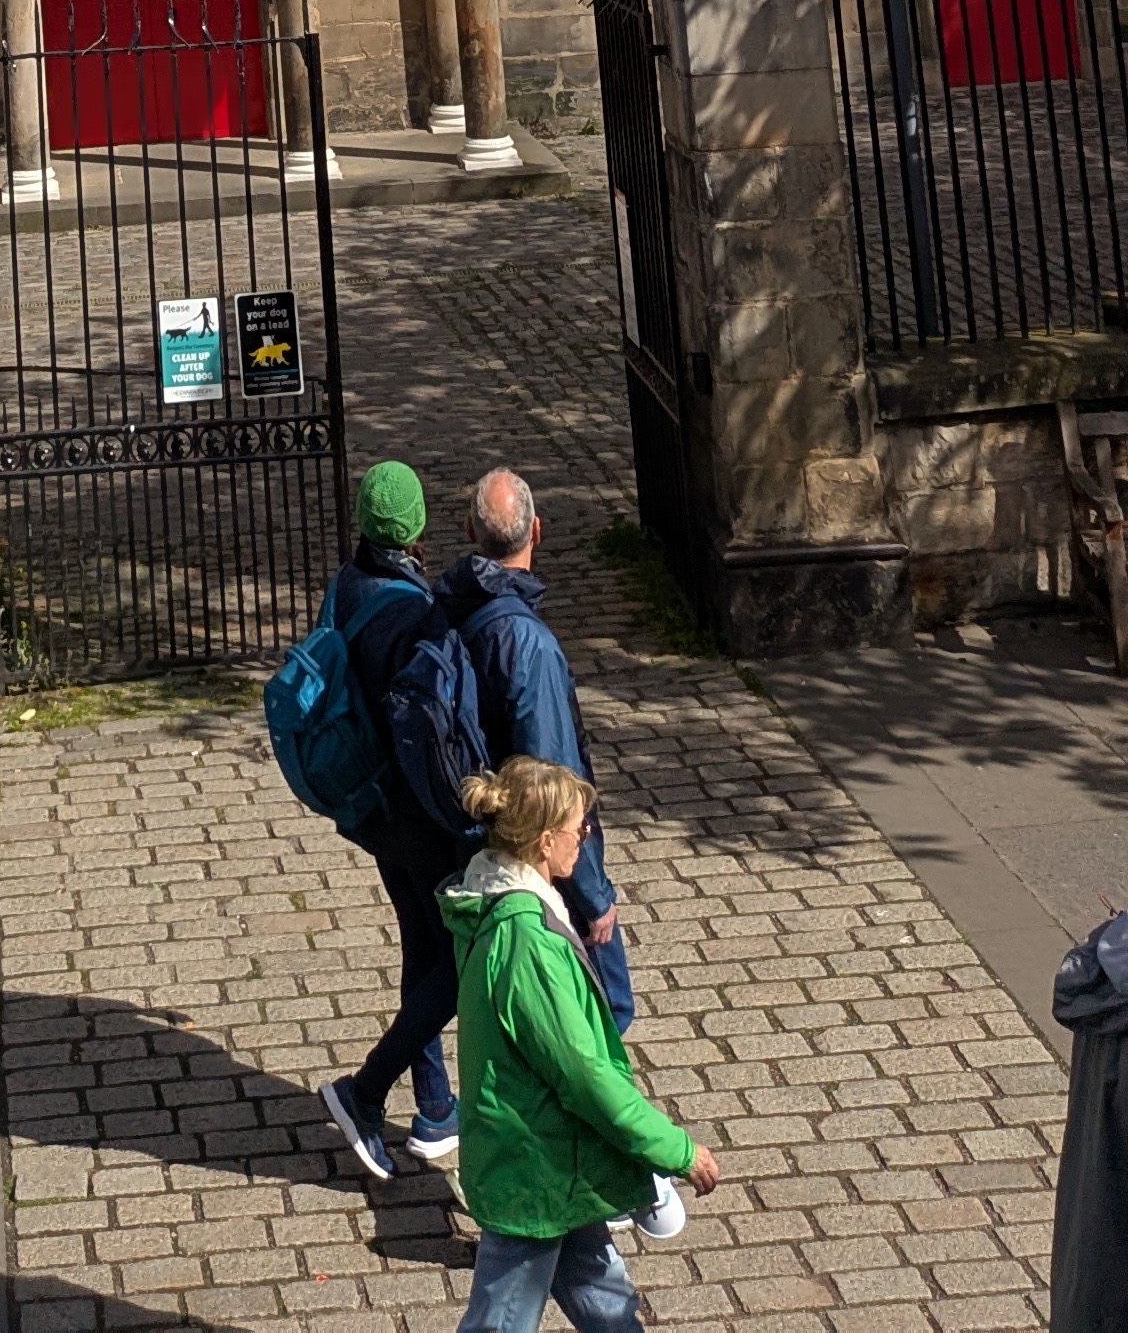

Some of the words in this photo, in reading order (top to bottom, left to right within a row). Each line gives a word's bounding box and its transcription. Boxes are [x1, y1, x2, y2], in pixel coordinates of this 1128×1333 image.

[253, 296, 278, 307] Keep
[162, 303, 191, 314] Please
[246, 310, 267, 322] your
[269, 308, 288, 318] dog
[245, 323, 258, 332] on
[260, 322, 267, 331] a
[267, 319, 290, 331] lead
[171, 352, 197, 363] CLEAN
[198, 351, 211, 361] UP
[179, 362, 205, 372] AFTER
[171, 372, 194, 384] YOUR
[195, 371, 214, 382] DOG
